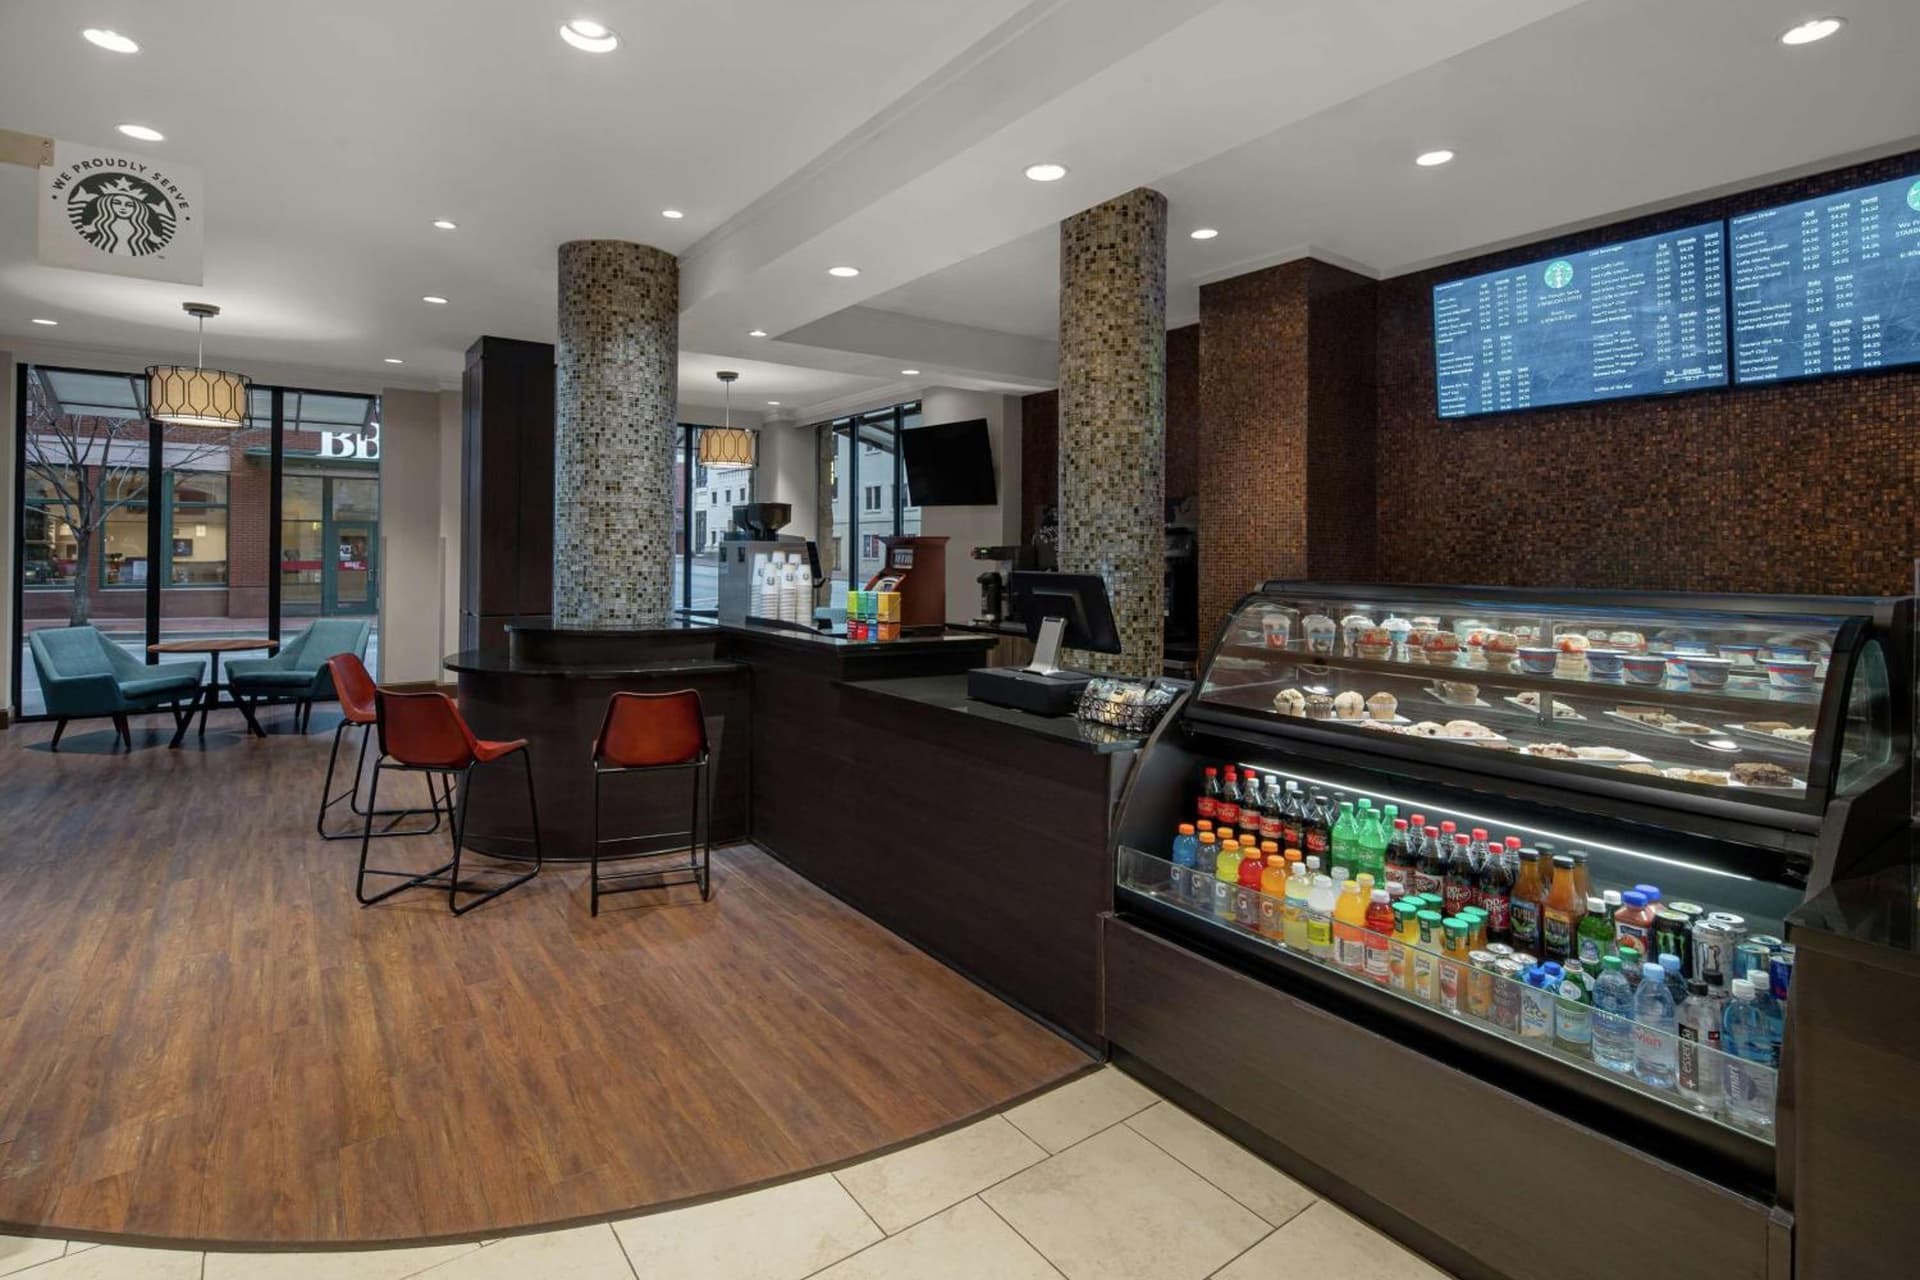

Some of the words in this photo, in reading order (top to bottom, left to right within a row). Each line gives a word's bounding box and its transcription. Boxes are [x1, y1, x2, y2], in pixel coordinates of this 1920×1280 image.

[53, 171, 72, 191] WE
[72, 158, 148, 174] PROUDLY
[151, 172, 190, 210] SERVE
